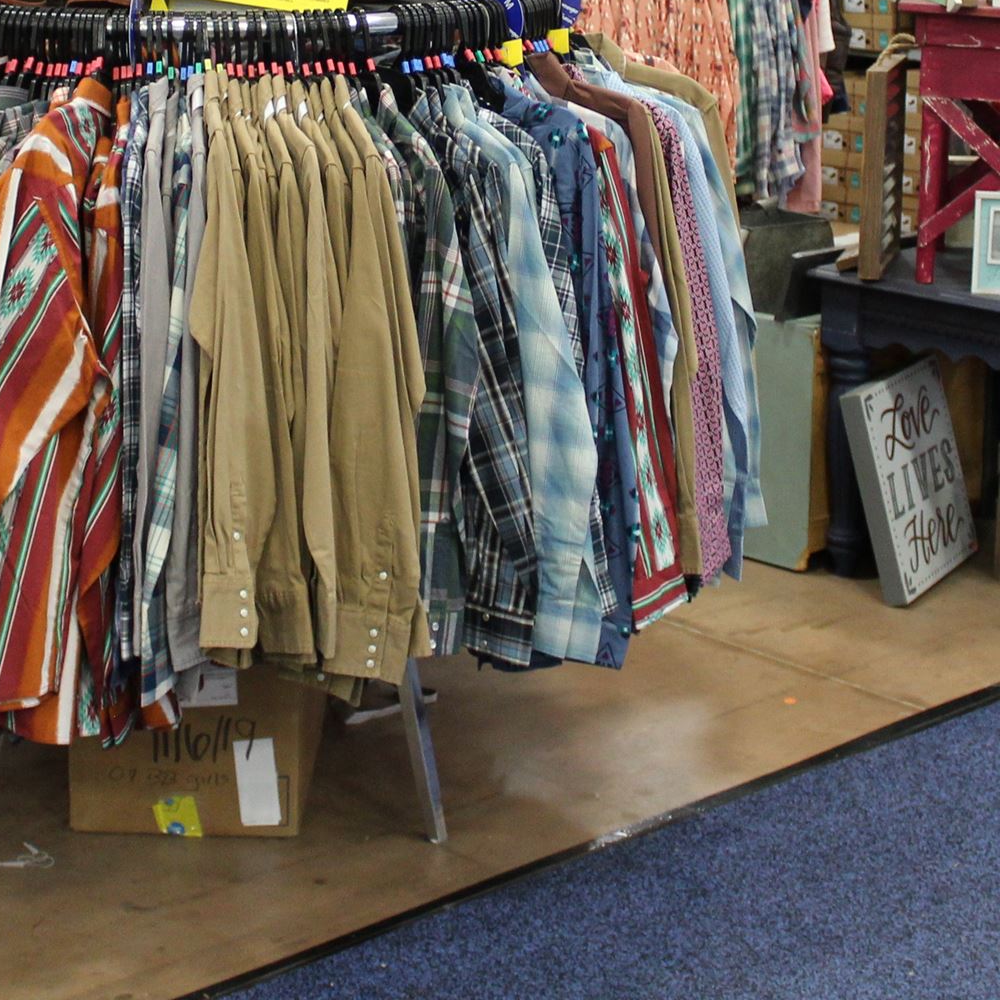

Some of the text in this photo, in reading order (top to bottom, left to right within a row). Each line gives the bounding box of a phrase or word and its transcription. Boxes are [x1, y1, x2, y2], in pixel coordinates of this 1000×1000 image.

[880, 384, 941, 461] Love
[886, 438, 956, 521] LIVES
[904, 502, 964, 574] Here
